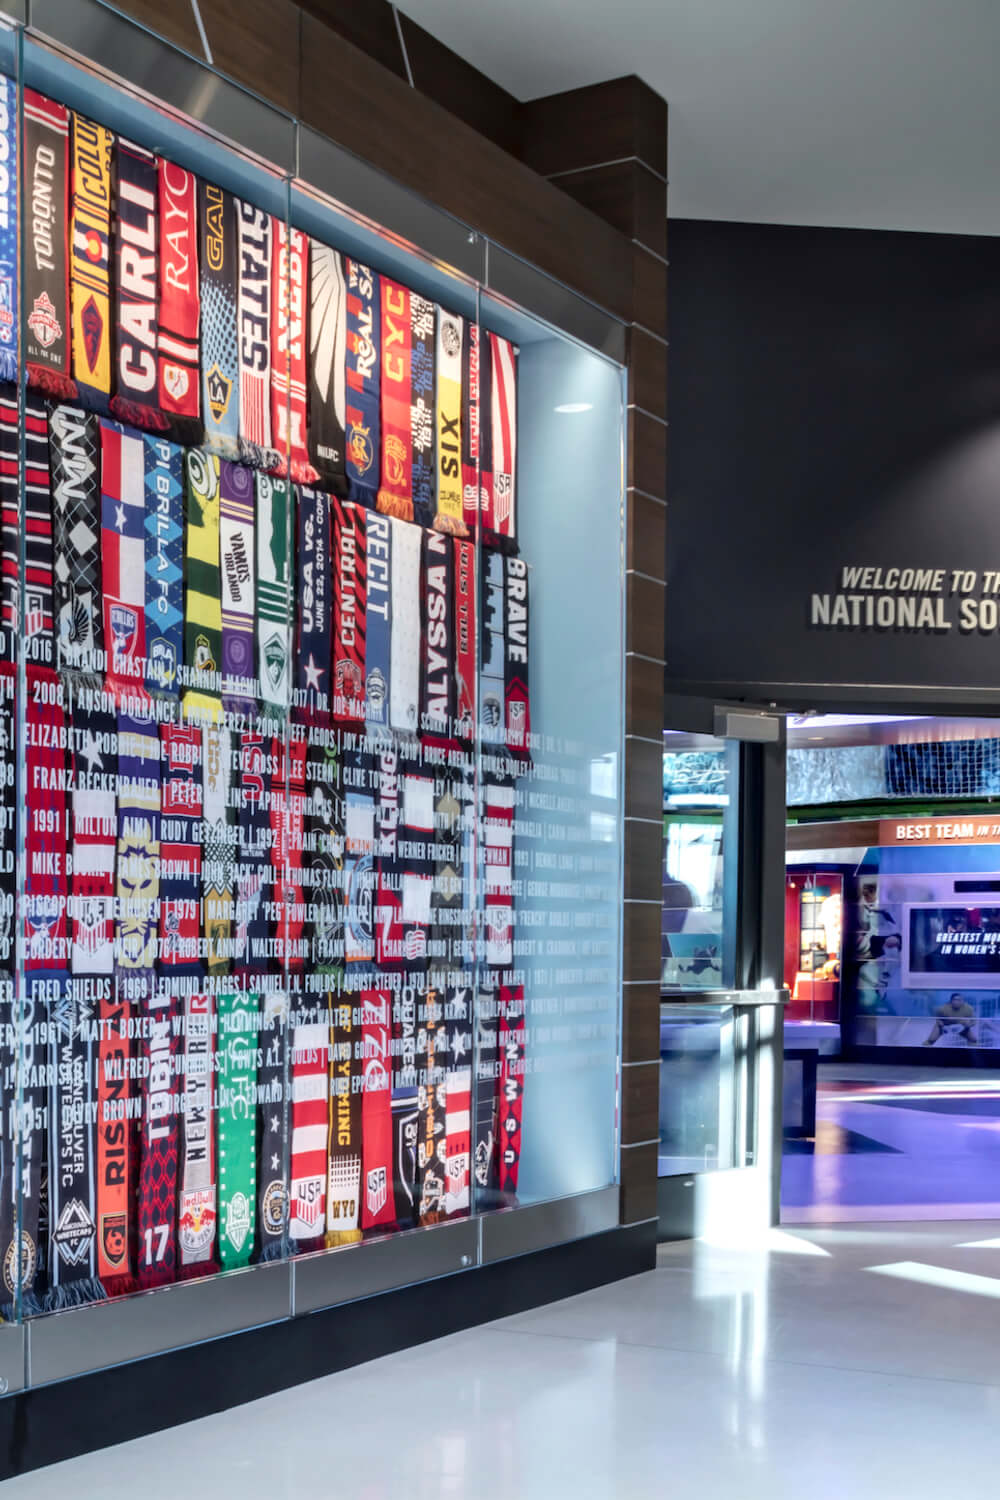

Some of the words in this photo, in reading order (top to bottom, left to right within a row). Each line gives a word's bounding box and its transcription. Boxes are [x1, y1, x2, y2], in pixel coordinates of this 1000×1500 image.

[35, 144, 56, 272] TORONTO
[119, 179, 157, 393] CARLI
[441, 412, 460, 479] SIX
[494, 470, 512, 494] USA
[155, 480, 170, 573] BRILLA
[229, 531, 250, 584] VAMOS
[315, 539, 325, 569] 2014
[224, 552, 242, 604] ORLANDO
[340, 523, 356, 649] CENTRAL
[842, 566, 946, 592] WELCOME
[951, 570, 977, 593] TO
[156, 579, 169, 615] FC
[302, 561, 314, 634] USA
[506, 557, 528, 664] BRAVE
[811, 594, 952, 628] NATIONAL
[315, 602, 325, 633] JUNE
[25, 636, 52, 662] 2016
[426, 564, 449, 723] ALYSSA
[33, 680, 63, 706] 2008
[120, 695, 175, 723] DORRANCE
[33, 766, 74, 793] FRANZ
[33, 809, 60, 833] 1991
[160, 818, 188, 842] RUDY
[896, 824, 932, 840] BEST
[935, 823, 974, 840] TEAM
[976, 826, 989, 837] IN
[32, 851, 61, 876] MIKE
[936, 932, 981, 943] GREATEST
[941, 945, 953, 955] IN
[31, 979, 60, 1002] FRED
[65, 976, 110, 999] SHIELDS
[123, 976, 147, 998] 1969
[159, 976, 198, 997] EDMUND
[203, 975, 240, 996] CRAGGS
[250, 974, 283, 995] SAMUEL
[305, 973, 335, 994] FOULDS
[343, 972, 373, 992] AUGUST
[33, 1021, 63, 1046] 1961
[81, 1018, 113, 1043] MATT
[104, 1057, 150, 1081] WILFRED
[104, 1097, 142, 1122] BROWN
[186, 1107, 207, 1163] NEW
[62, 1163, 73, 1189] FC
[367, 1171, 386, 1193] USA
[449, 1159, 467, 1178] USA
[299, 1179, 322, 1203] USA
[332, 1200, 356, 1220] WYO
[144, 1224, 170, 1266] 17
